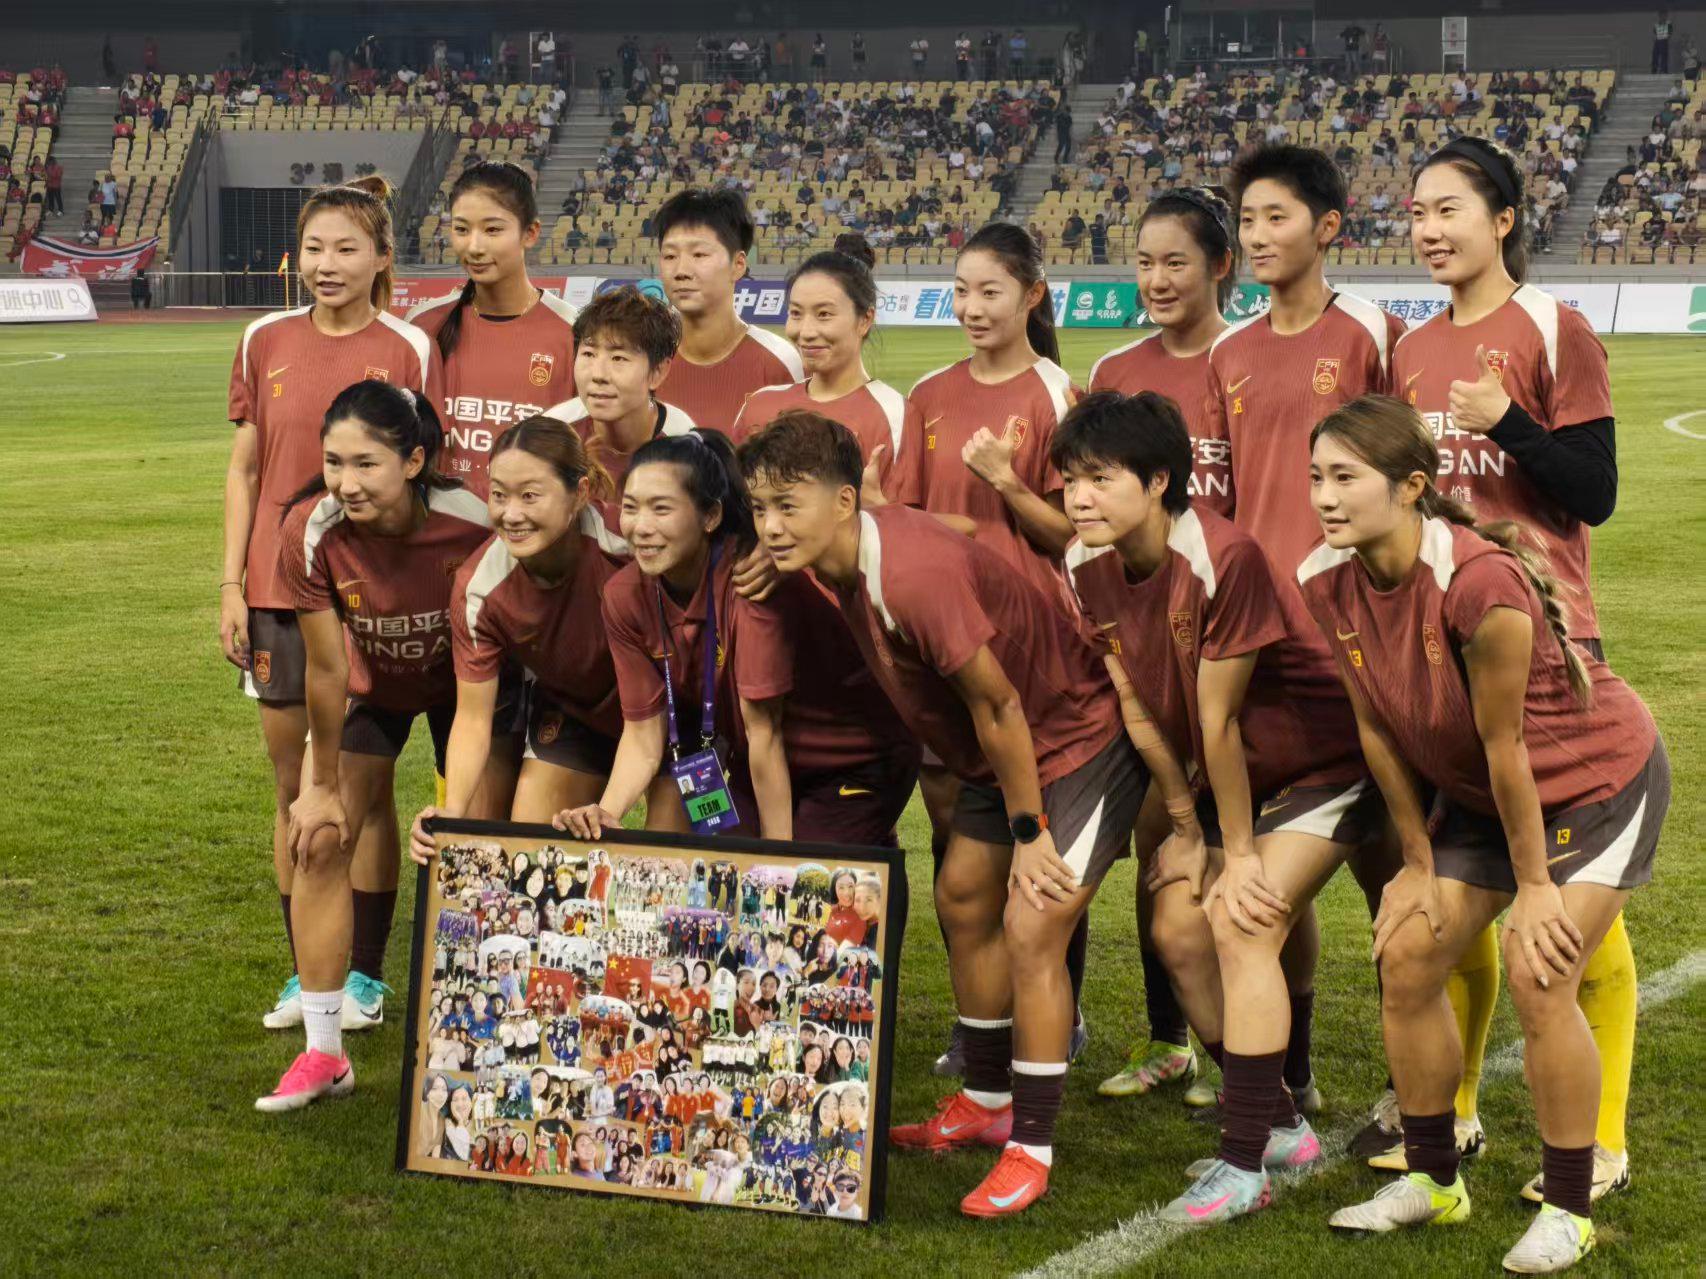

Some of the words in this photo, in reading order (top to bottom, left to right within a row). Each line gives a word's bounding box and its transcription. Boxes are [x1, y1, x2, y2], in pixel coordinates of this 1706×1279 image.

[348, 594, 360, 608] 10
[353, 608, 451, 637] 中国平
[697, 800, 721, 817] TEAM
[1556, 828, 1571, 845] 13
